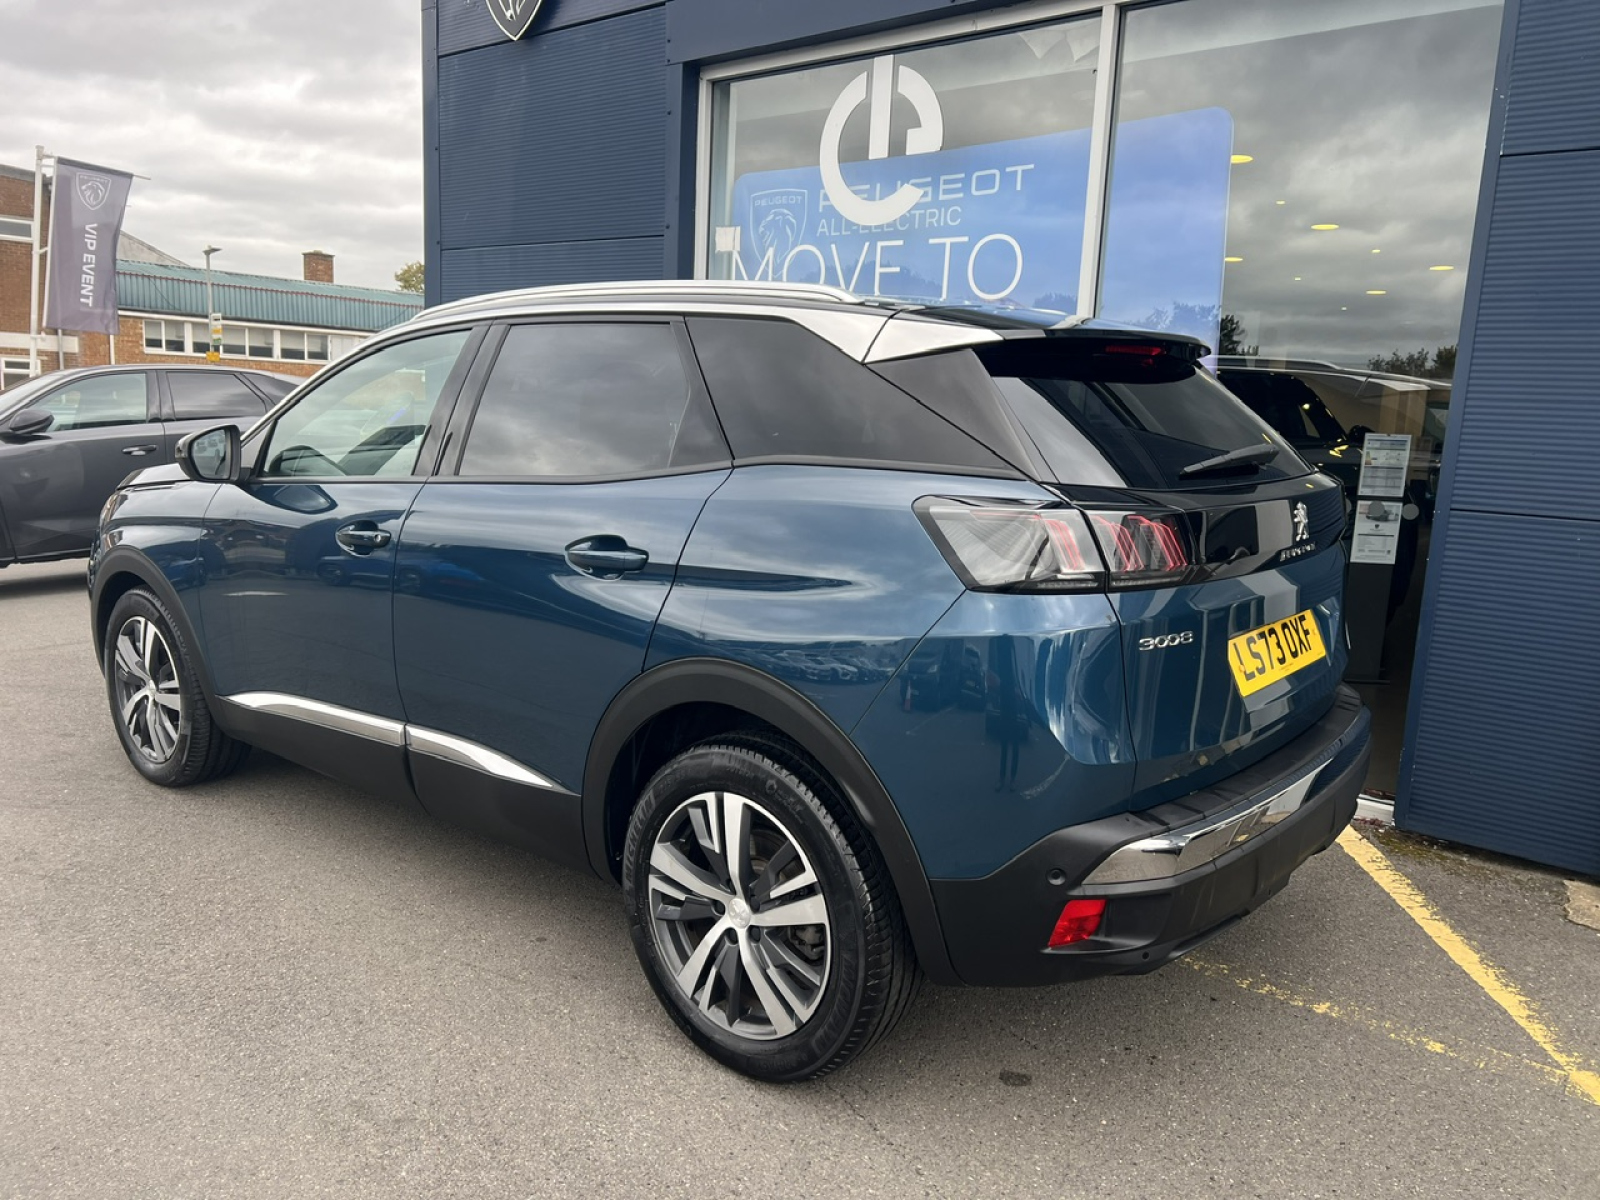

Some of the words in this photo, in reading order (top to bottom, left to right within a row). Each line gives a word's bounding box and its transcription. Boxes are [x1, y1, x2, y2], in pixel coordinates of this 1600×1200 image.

[754, 195, 803, 206] PEUGEOT
[84, 223, 98, 250] VIP
[731, 240, 905, 297] MOVE
[928, 233, 1023, 300] TO
[80, 254, 96, 307] EVENT
[1139, 630, 1194, 651] 3008
